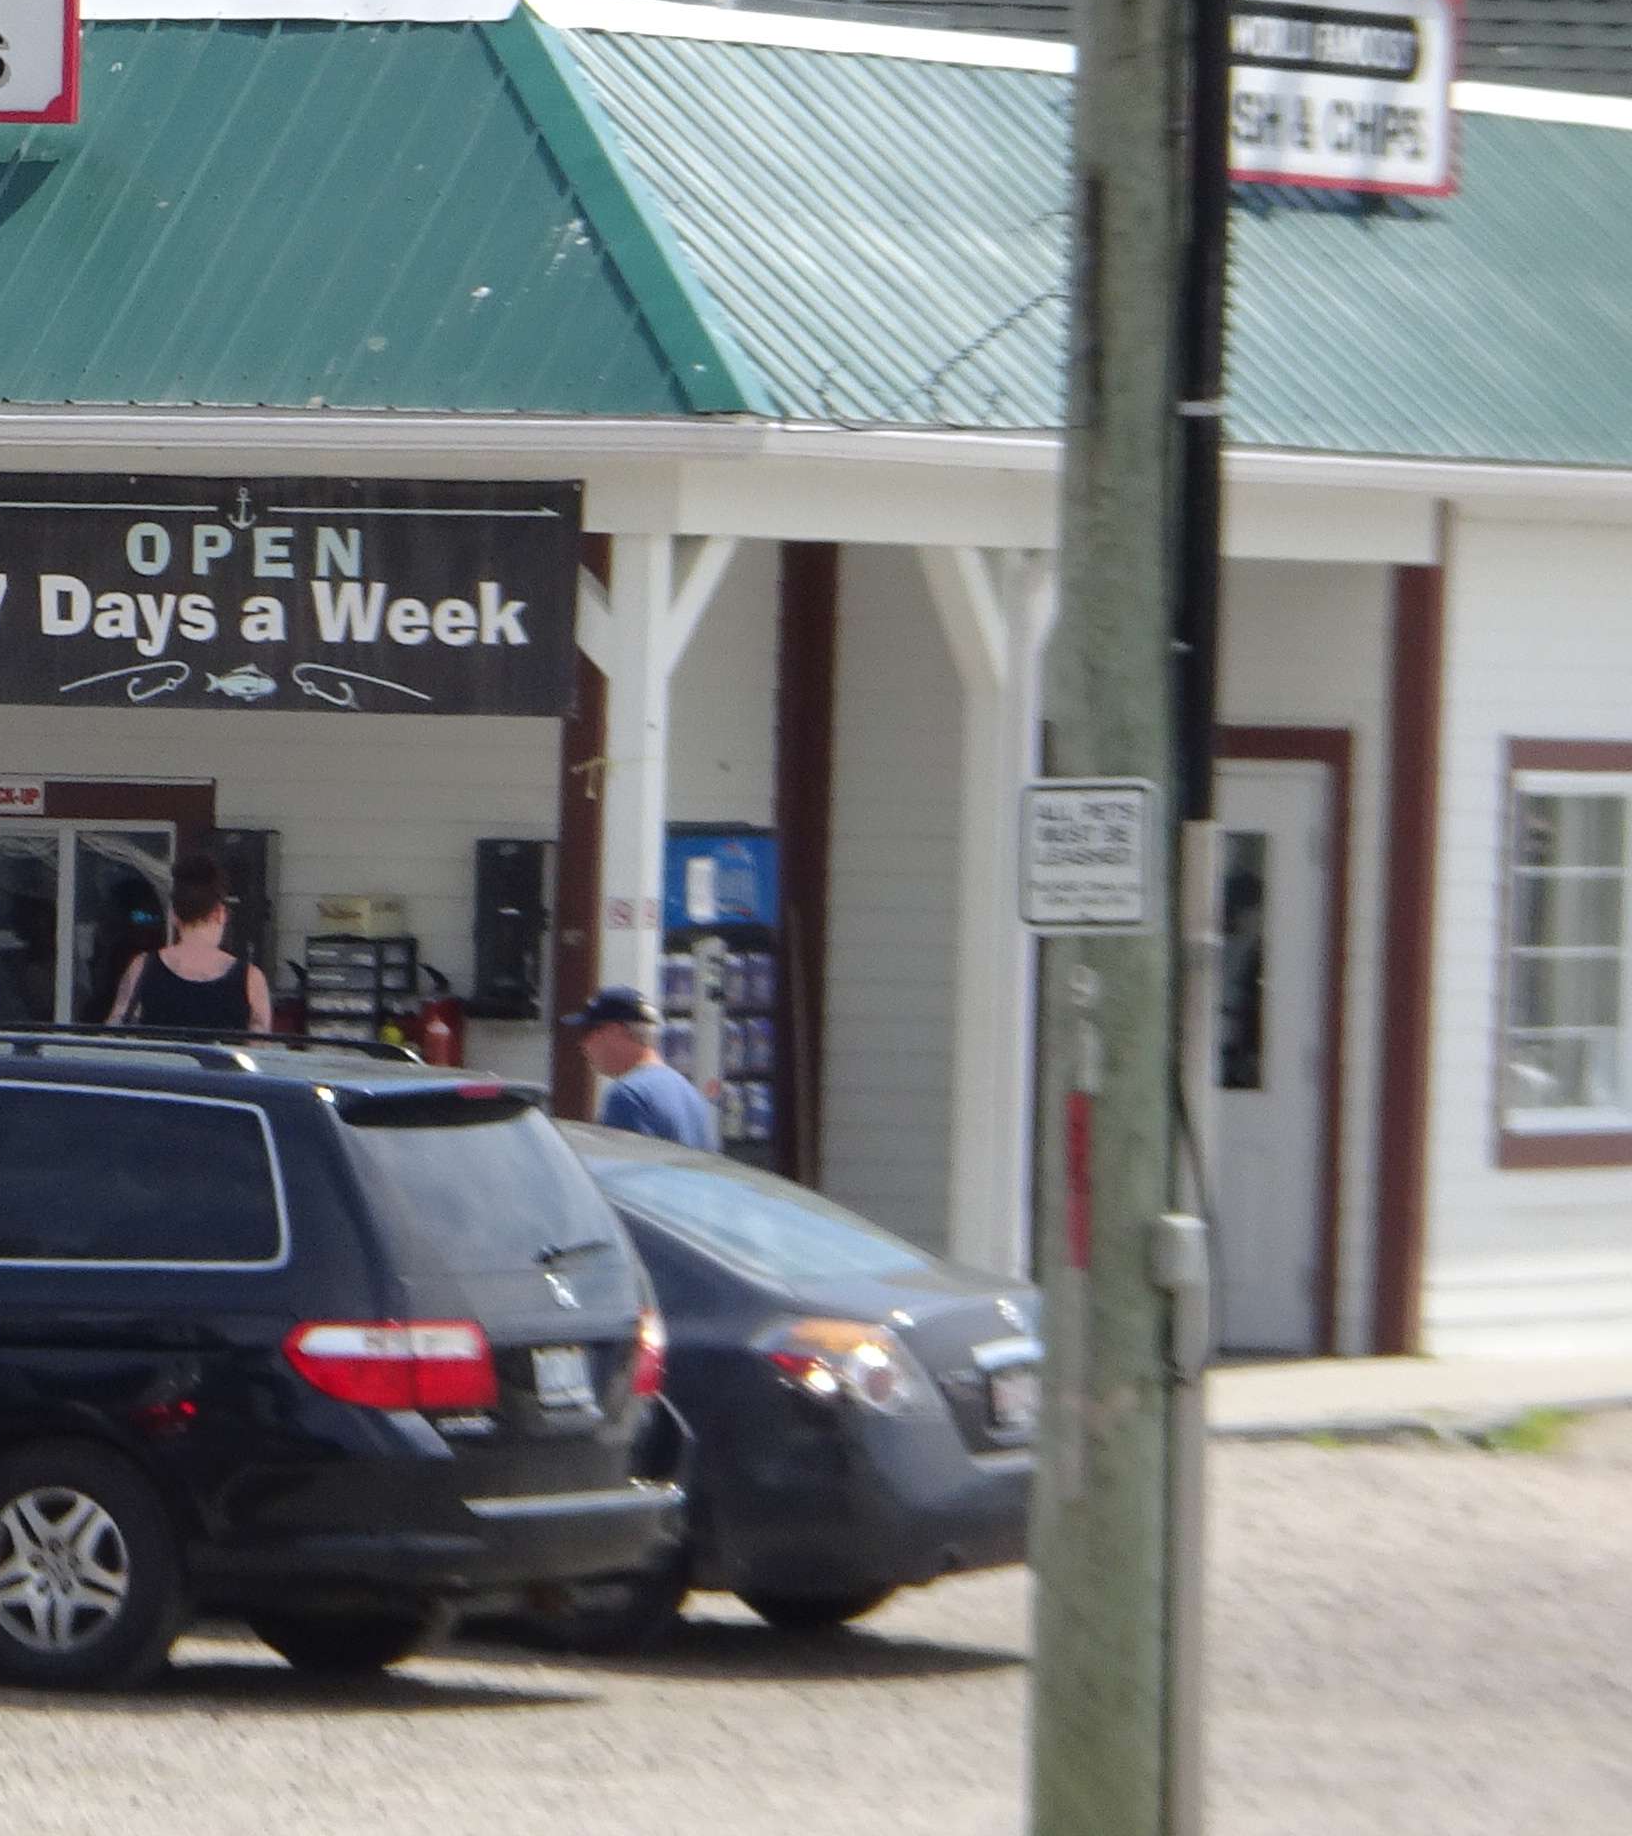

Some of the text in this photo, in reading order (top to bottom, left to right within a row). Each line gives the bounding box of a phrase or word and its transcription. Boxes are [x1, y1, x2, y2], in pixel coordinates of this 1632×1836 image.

[1232, 91, 1286, 150] SH
[126, 522, 363, 580] OPEN
[39, 574, 216, 657] Days
[241, 595, 286, 643] a
[310, 579, 530, 647] Week
